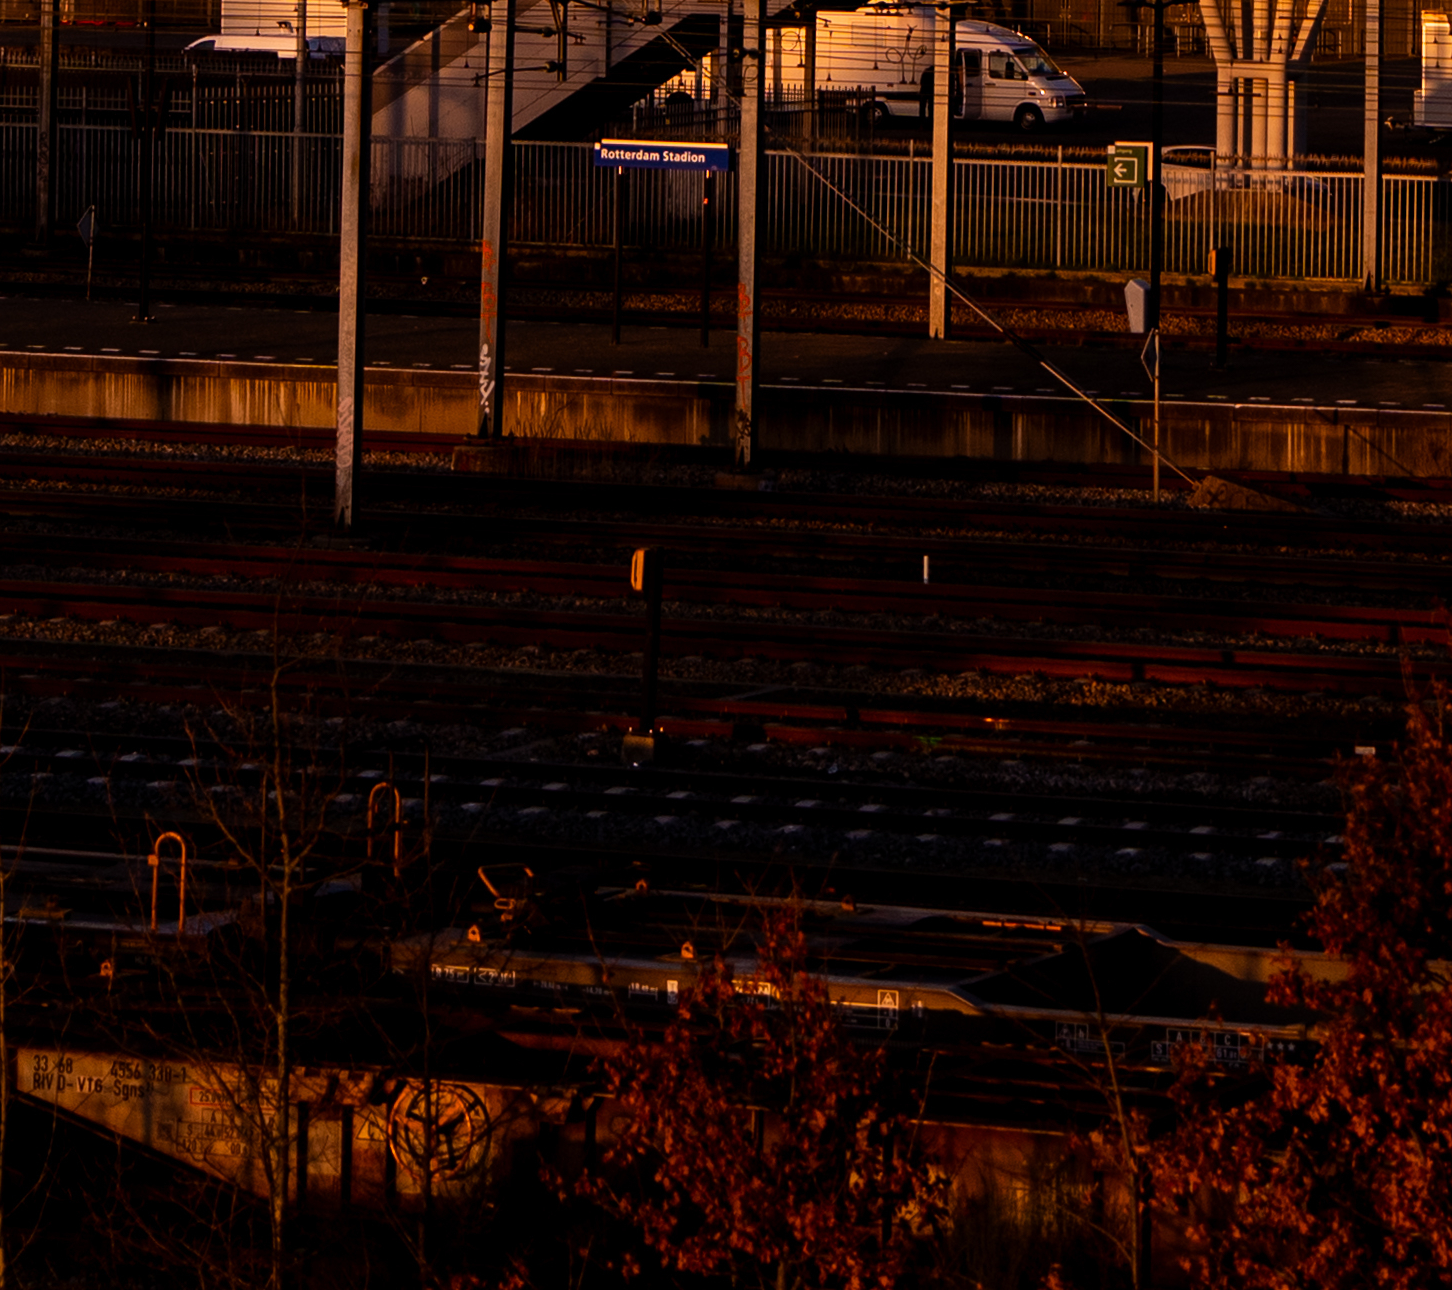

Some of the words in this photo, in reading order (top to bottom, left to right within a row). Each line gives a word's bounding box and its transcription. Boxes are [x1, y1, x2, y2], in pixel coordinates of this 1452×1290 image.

[600, 147, 660, 161] Rotterdam
[662, 150, 706, 164] Stadion
[33, 1054, 48, 1072] 33
[57, 1056, 73, 1074] 68
[110, 1060, 141, 1080] 4556
[33, 1072, 54, 1090] RIV
